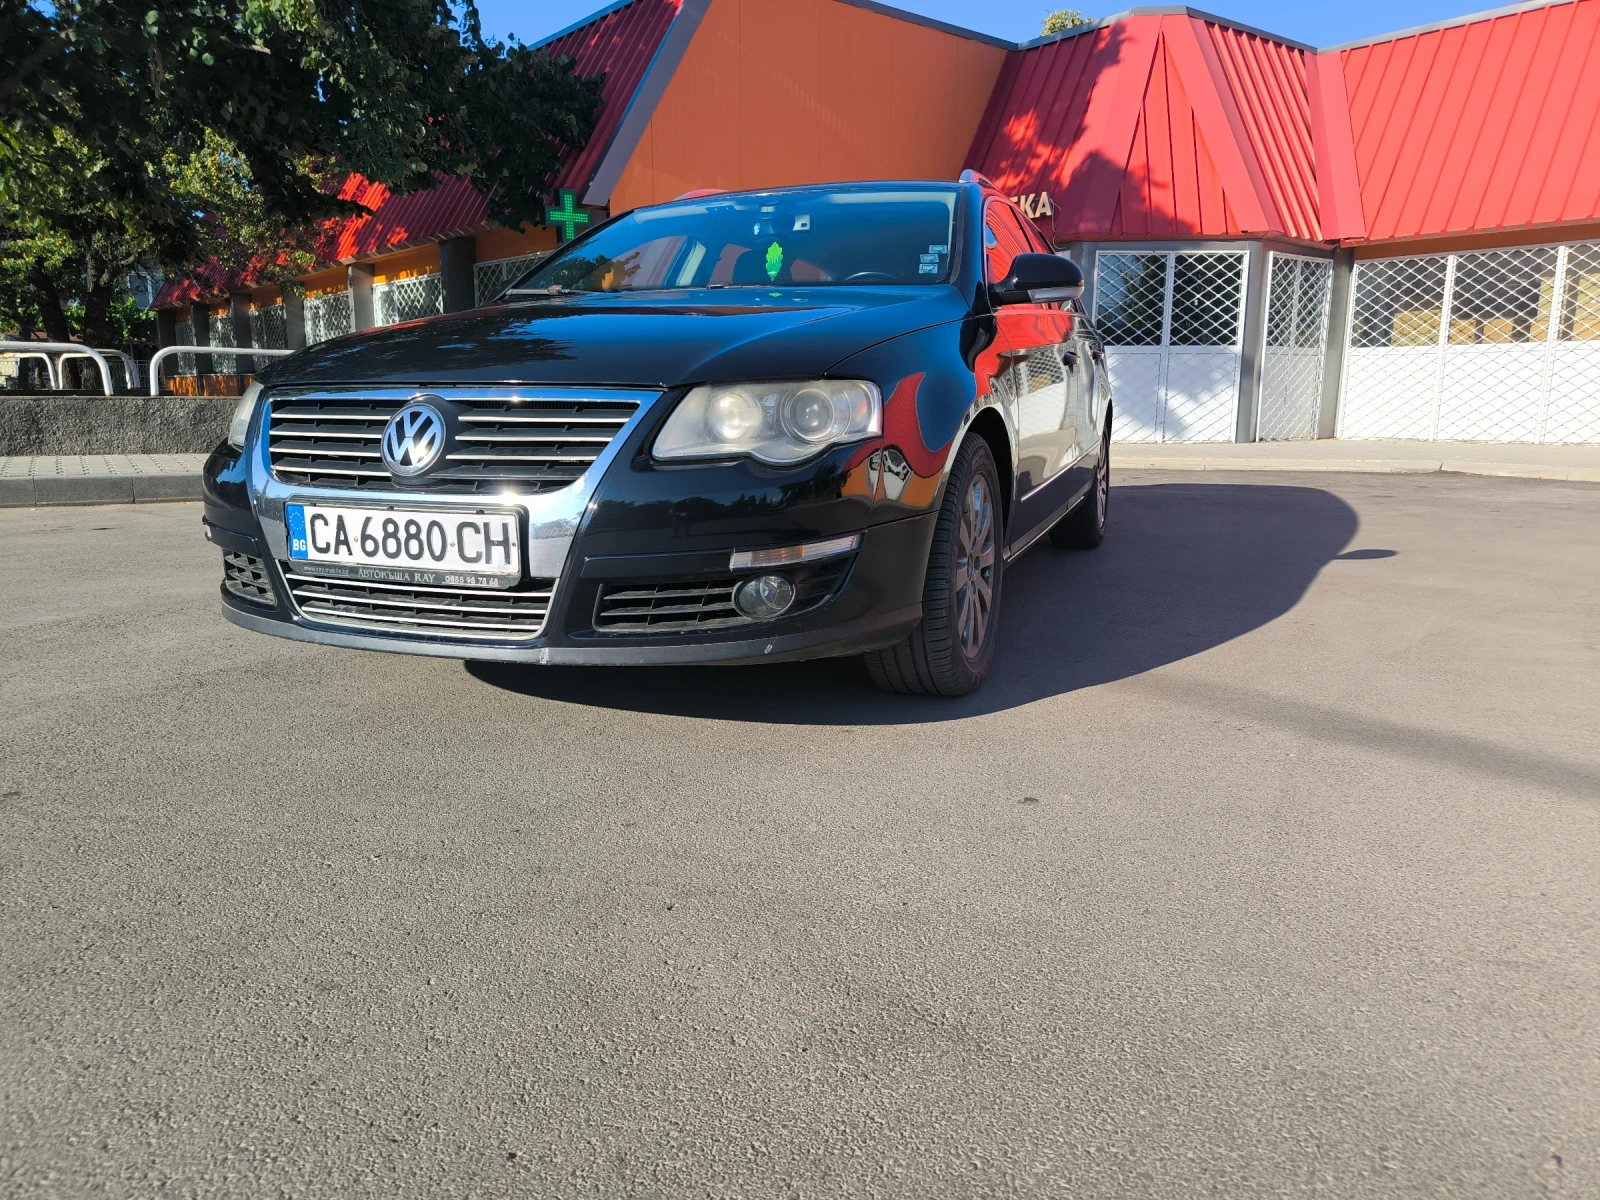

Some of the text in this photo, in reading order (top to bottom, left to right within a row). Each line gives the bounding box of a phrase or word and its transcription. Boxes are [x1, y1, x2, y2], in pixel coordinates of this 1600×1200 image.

[292, 538, 307, 551] BG
[309, 513, 511, 565] CA 6880 CH
[414, 572, 435, 583] RAY
[445, 575, 464, 583] 0885
[477, 577, 487, 585] 78
